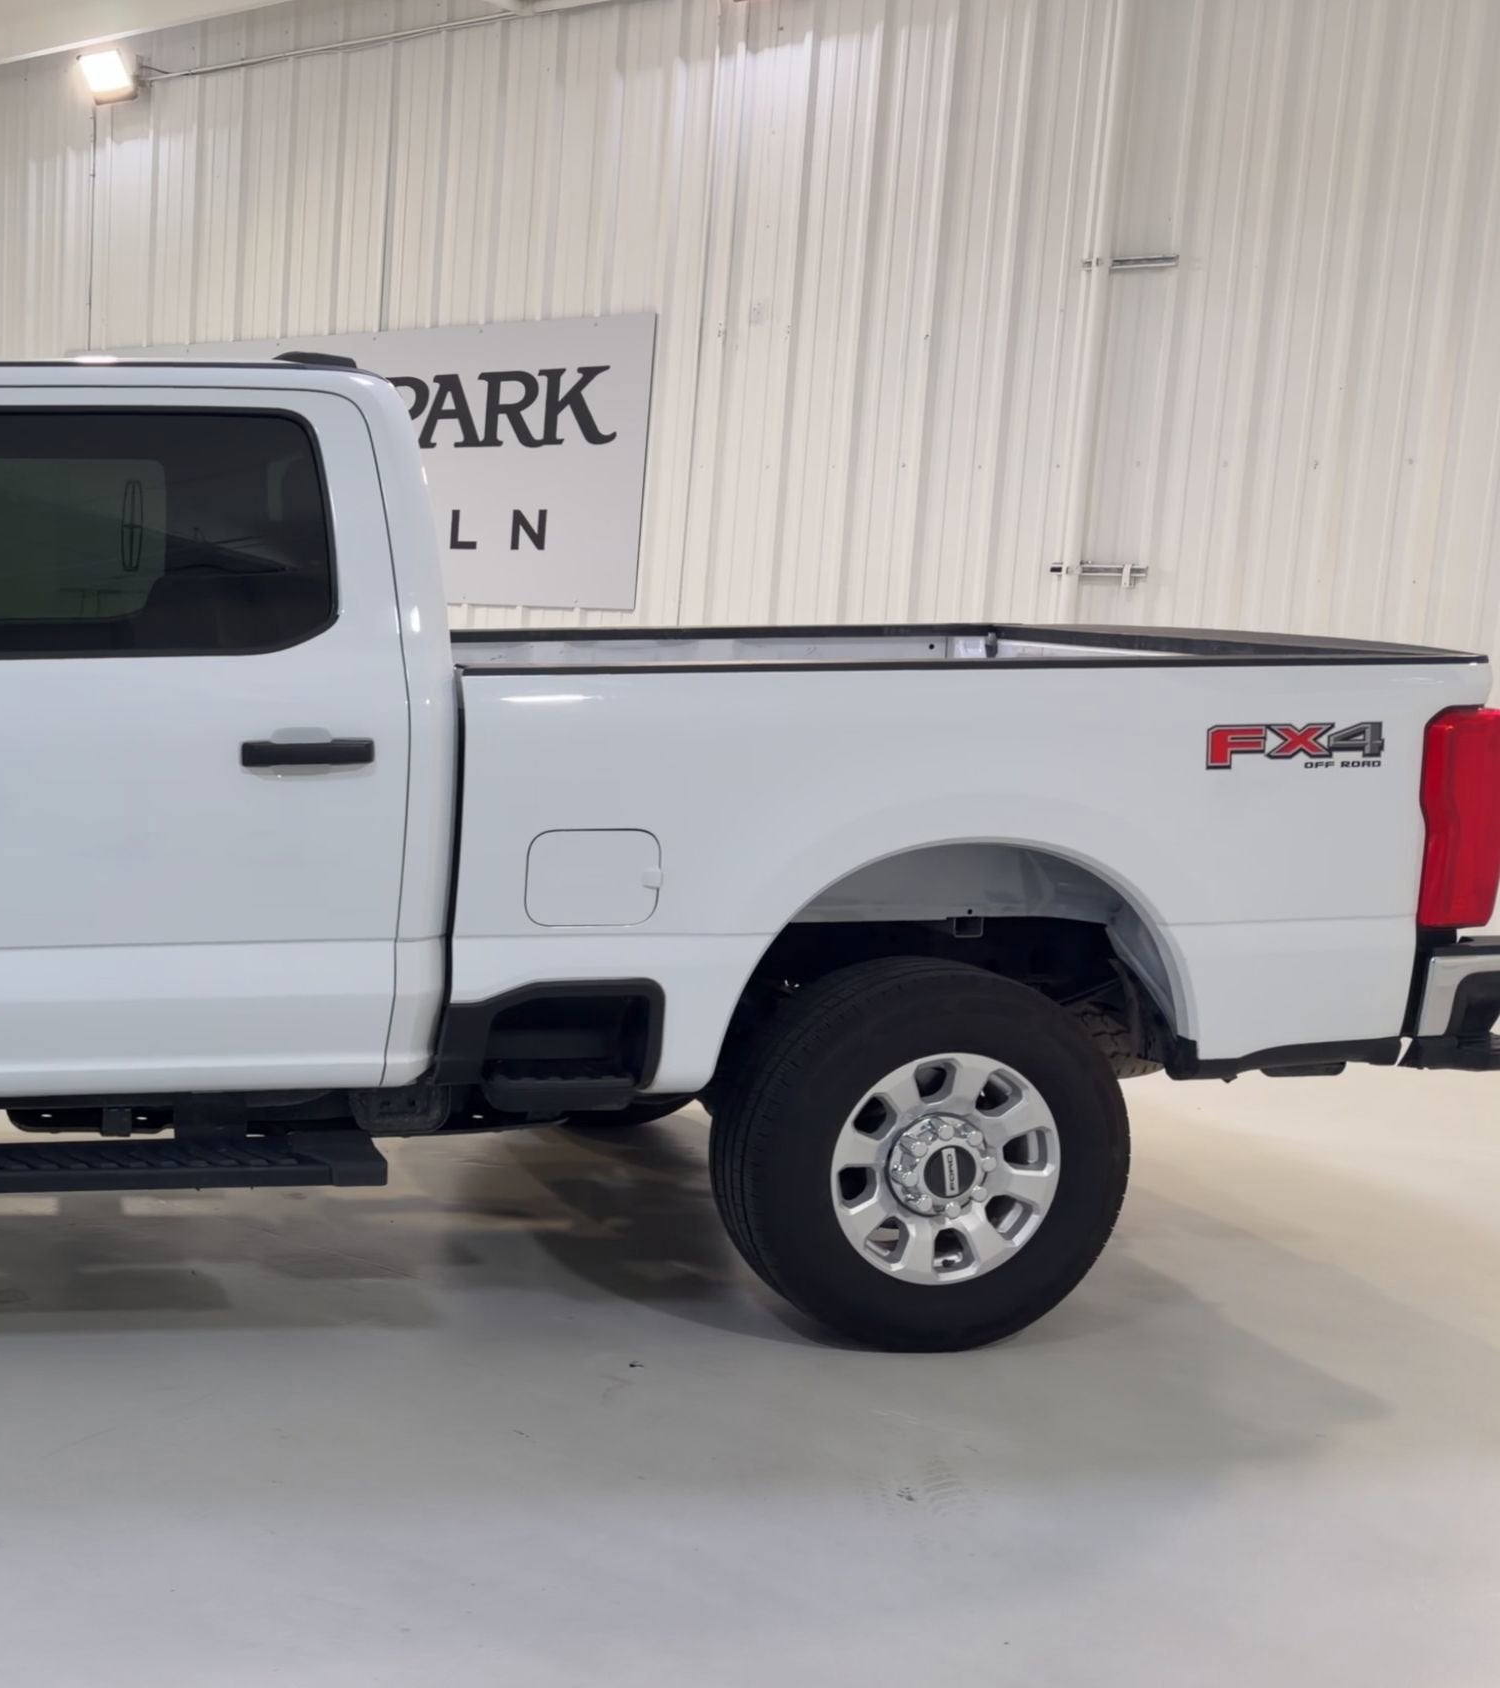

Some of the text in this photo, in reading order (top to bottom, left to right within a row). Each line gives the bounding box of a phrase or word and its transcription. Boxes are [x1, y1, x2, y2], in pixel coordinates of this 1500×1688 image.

[1205, 720, 1385, 770] FX4
[1304, 759, 1382, 769] OFF ROAD
[946, 1152, 956, 1192] FORD
